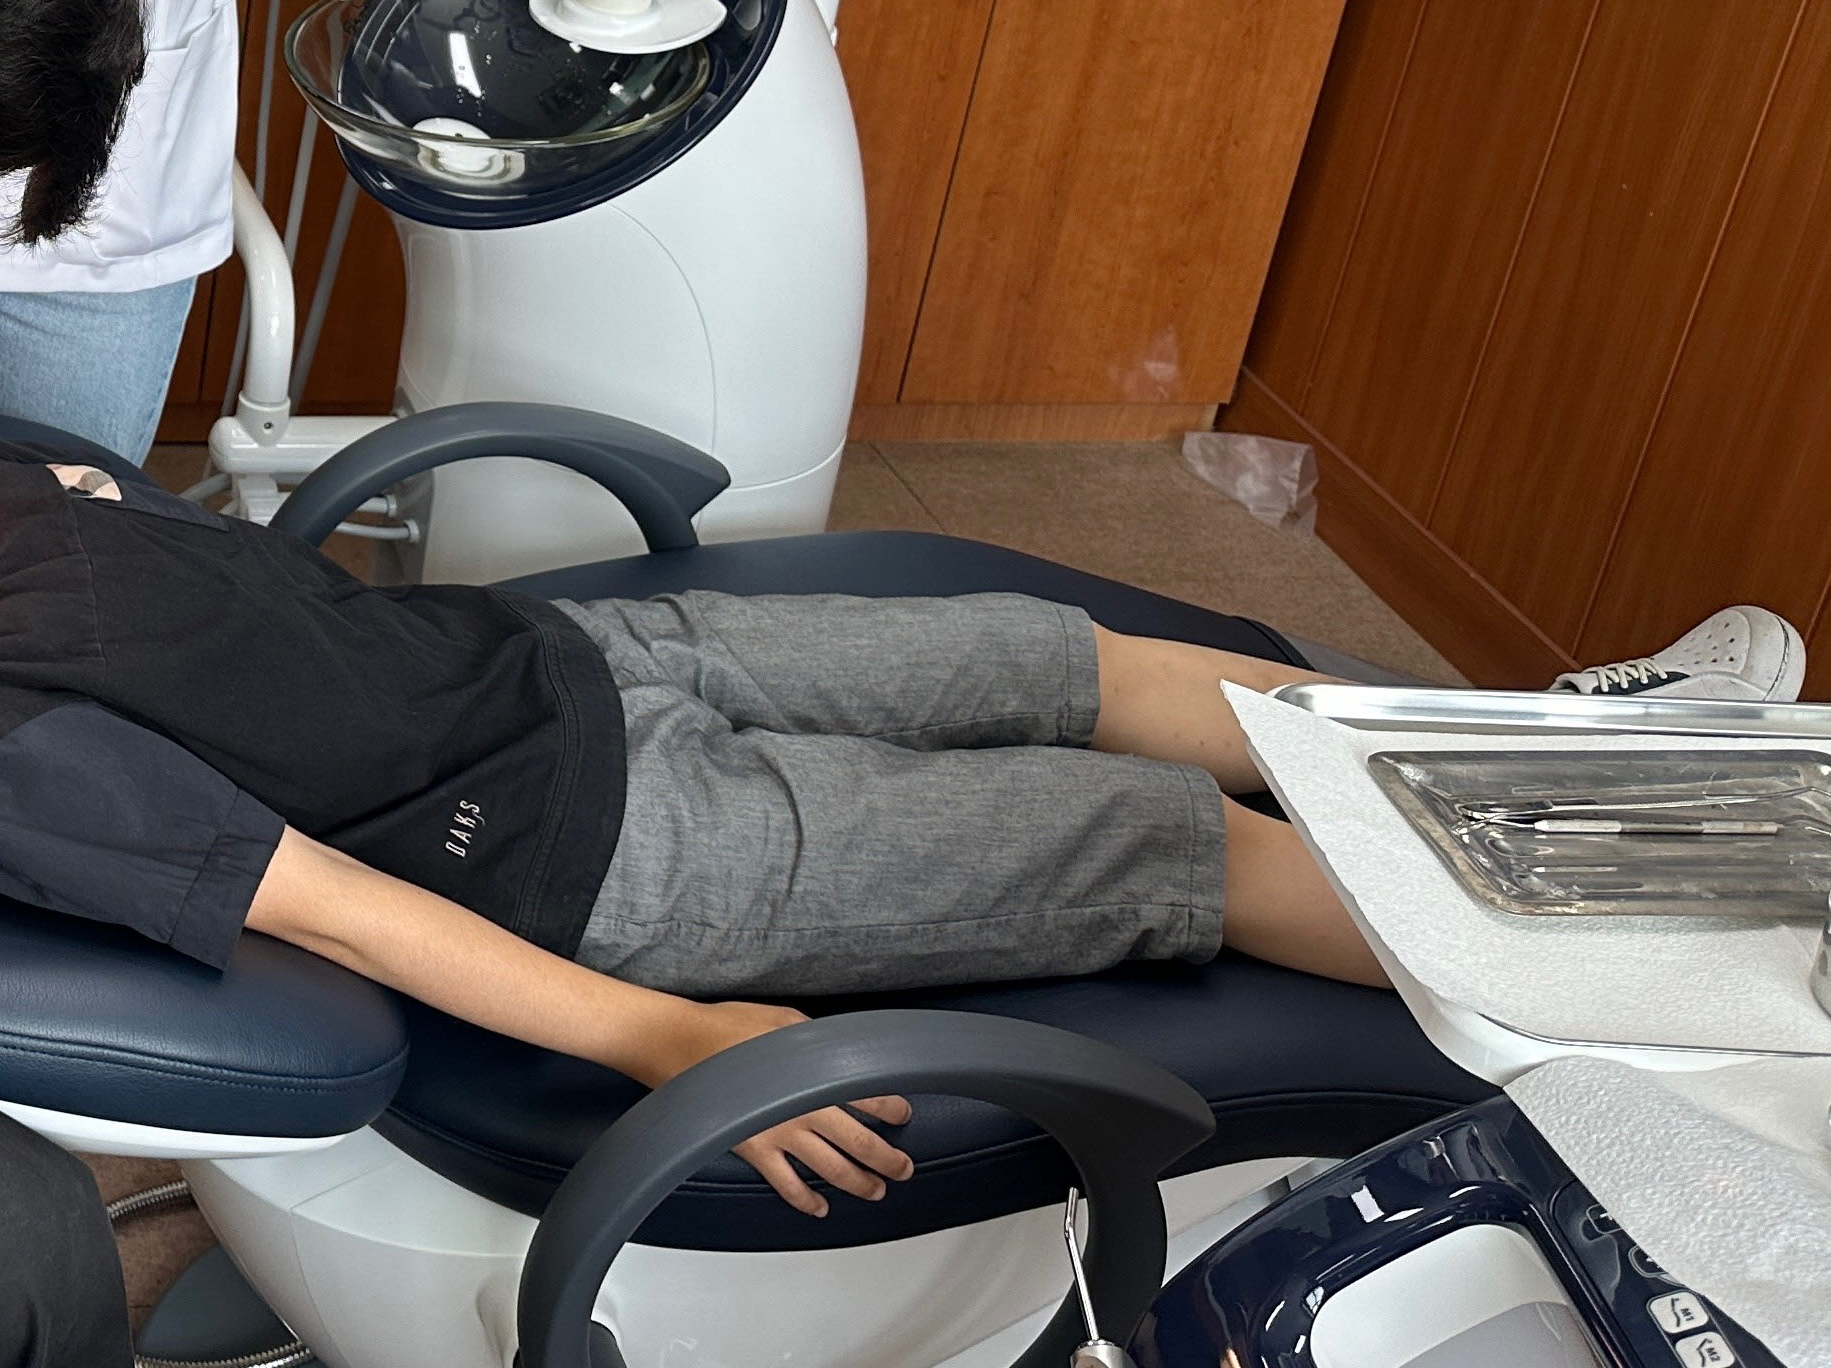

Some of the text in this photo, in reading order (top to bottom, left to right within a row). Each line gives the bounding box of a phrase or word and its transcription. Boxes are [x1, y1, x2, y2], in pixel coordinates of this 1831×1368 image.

[445, 800, 480, 858] DAKS
[1680, 1308, 1695, 1322] M1
[1705, 1347, 1721, 1363] M2
